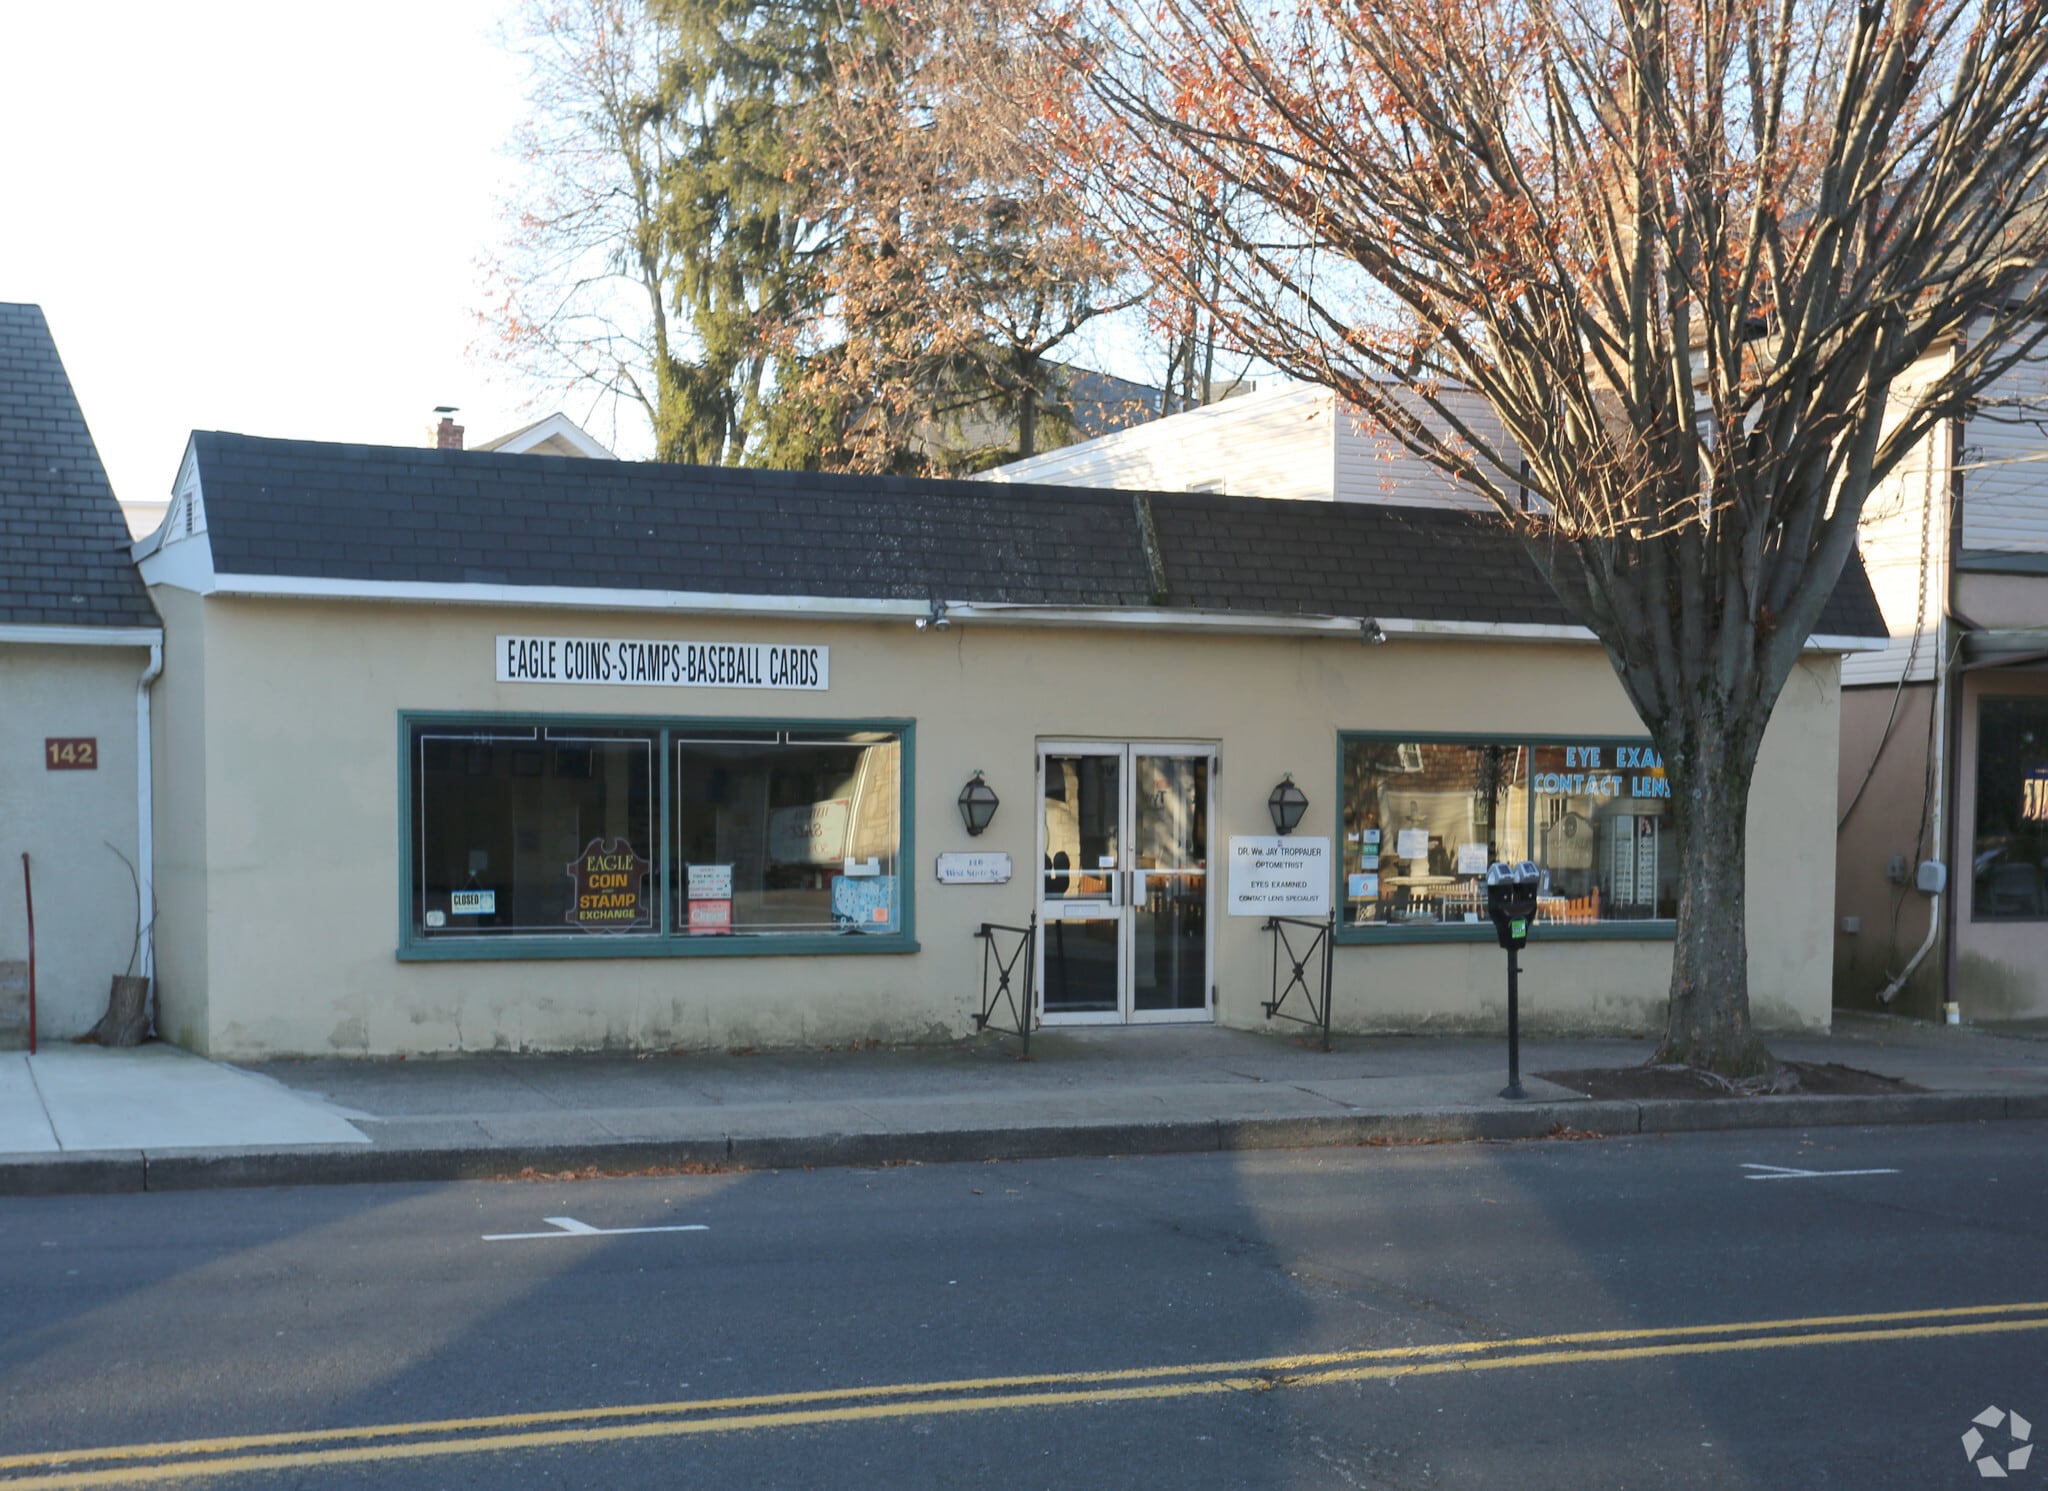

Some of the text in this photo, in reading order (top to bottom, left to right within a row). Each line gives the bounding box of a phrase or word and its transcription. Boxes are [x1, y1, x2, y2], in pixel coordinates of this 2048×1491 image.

[507, 639, 818, 687] EAGLE COINS-STAMPS-BASEBALL CARDS
[49, 742, 93, 765] 142
[1566, 746, 1601, 768] EYE
[1534, 772, 1622, 797] CONTACT
[1237, 847, 1250, 857] DR.
[1266, 848, 1278, 856] JAY
[1281, 848, 1322, 857] TROPPAUER
[587, 855, 634, 872] EAGLE
[1255, 861, 1303, 869] OPTOMETRIST
[589, 874, 628, 889] COIN
[1251, 881, 1307, 889] EYES EXAMINED
[453, 893, 479, 905] CLOSED
[580, 893, 636, 909] STAMP
[1286, 895, 1319, 903] SPECIALIST
[579, 909, 636, 920] EXCHANGE
